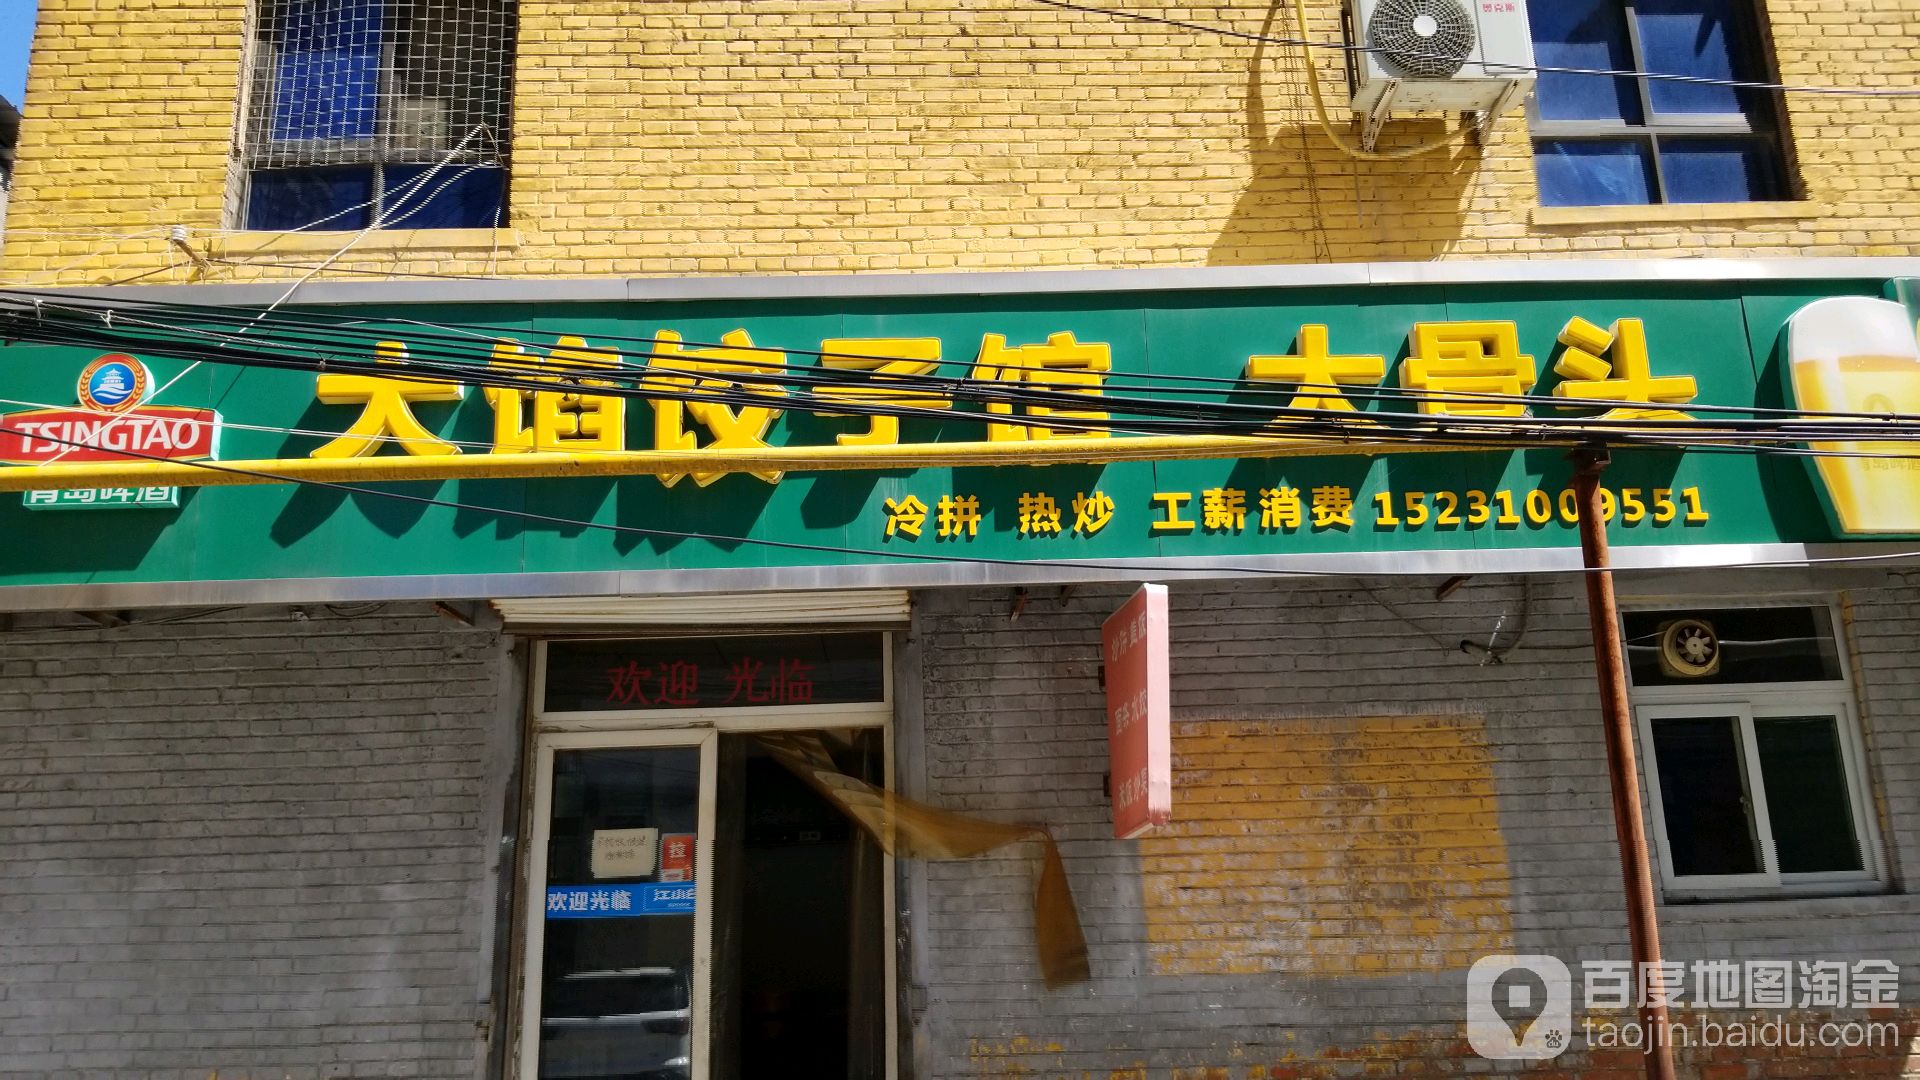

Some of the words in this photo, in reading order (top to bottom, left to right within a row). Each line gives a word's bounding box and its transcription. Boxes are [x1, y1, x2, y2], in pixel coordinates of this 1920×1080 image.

[1245, 316, 1698, 430] 大骨头
[14, 418, 200, 453] TSINGTAO
[885, 494, 982, 537] 冷拼
[1017, 491, 1115, 533] 热炒
[1152, 486, 1354, 530] 工薪消费
[1374, 486, 1709, 526] 15231009551
[606, 659, 700, 705] 欢迎
[726, 656, 816, 704] 光临
[547, 890, 632, 911] 欢迎光临
